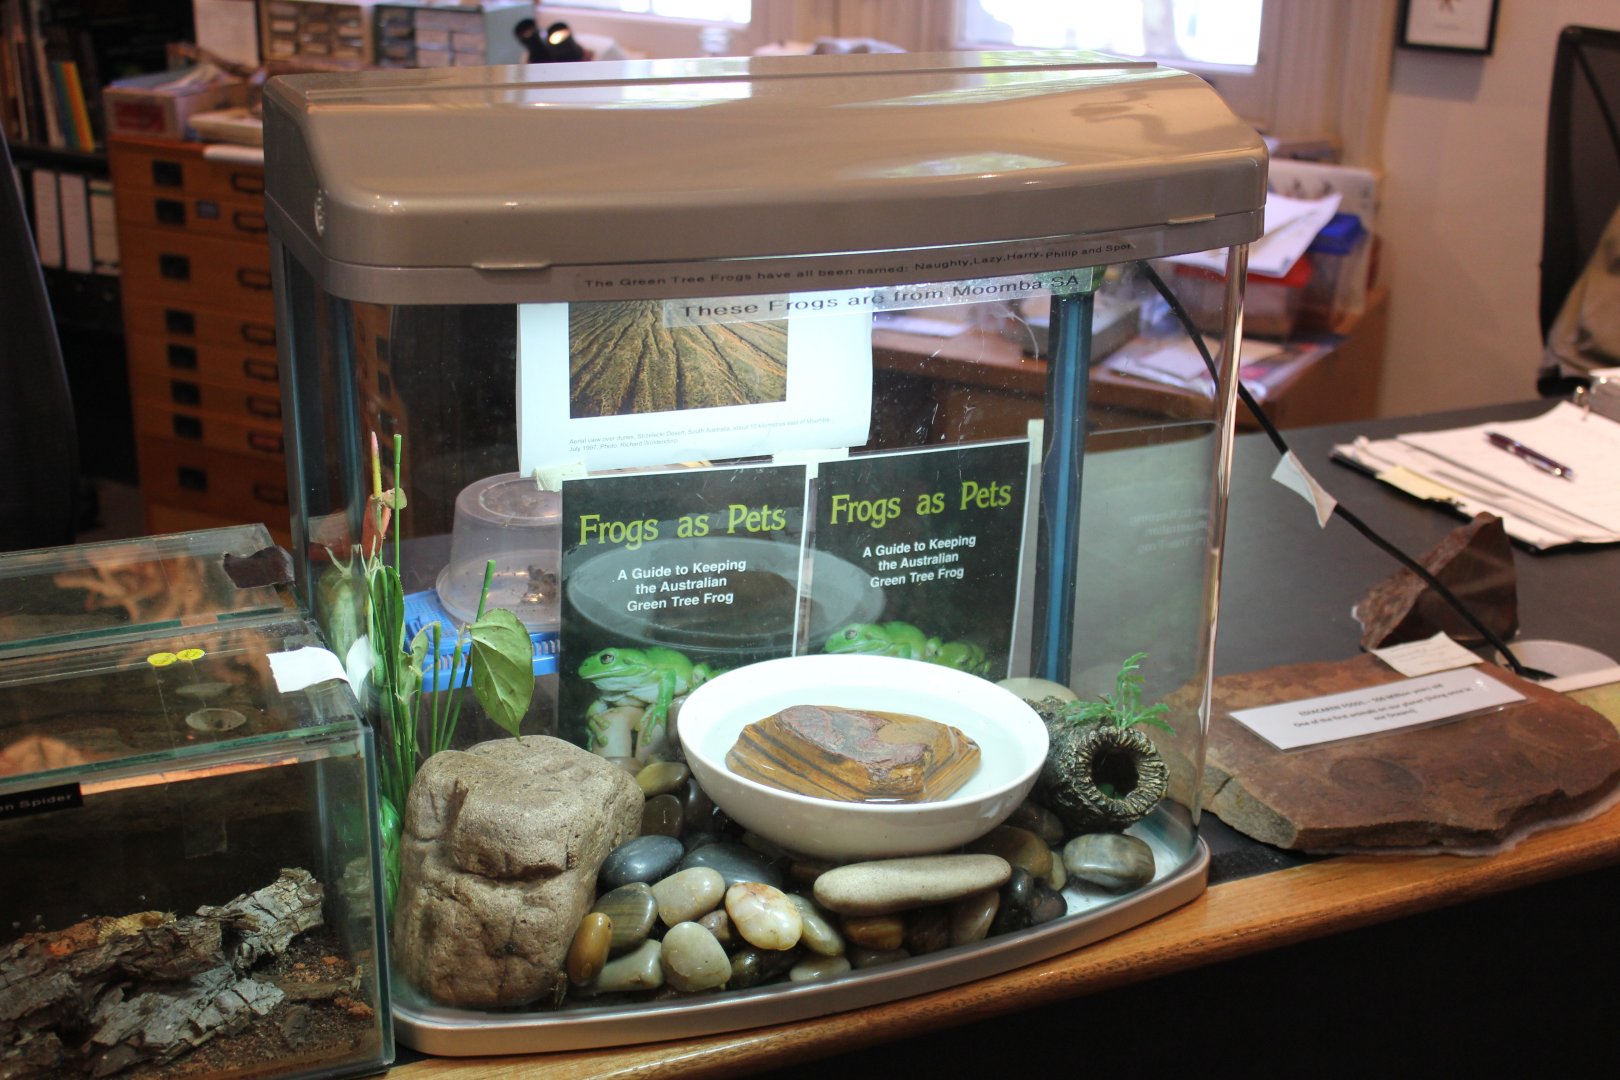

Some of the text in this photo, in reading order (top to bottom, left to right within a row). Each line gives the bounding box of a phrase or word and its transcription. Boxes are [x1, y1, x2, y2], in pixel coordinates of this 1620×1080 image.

[584, 279, 614, 289] The
[619, 276, 667, 287] Green
[672, 274, 705, 284] Tree
[710, 272, 752, 284] Frogs
[757, 270, 792, 280] have
[796, 268, 813, 279] all
[817, 266, 853, 277] been
[858, 264, 909, 275] named:
[1081, 245, 1102, 256] and
[682, 273, 1080, 318] These Frogs are from Moomba SA
[830, 481, 1012, 529] Frogs as Pets
[579, 503, 787, 550] Frogs as Pets
[862, 535, 976, 558] A Guide to Keeping
[617, 560, 747, 581] A Guide to Keeping
[878, 552, 959, 571] the Australian
[635, 576, 728, 595] the Australian
[869, 566, 965, 588] Green Tree Frog
[626, 591, 734, 612] Green Tree Frog
[19, 793, 73, 809] Spider
